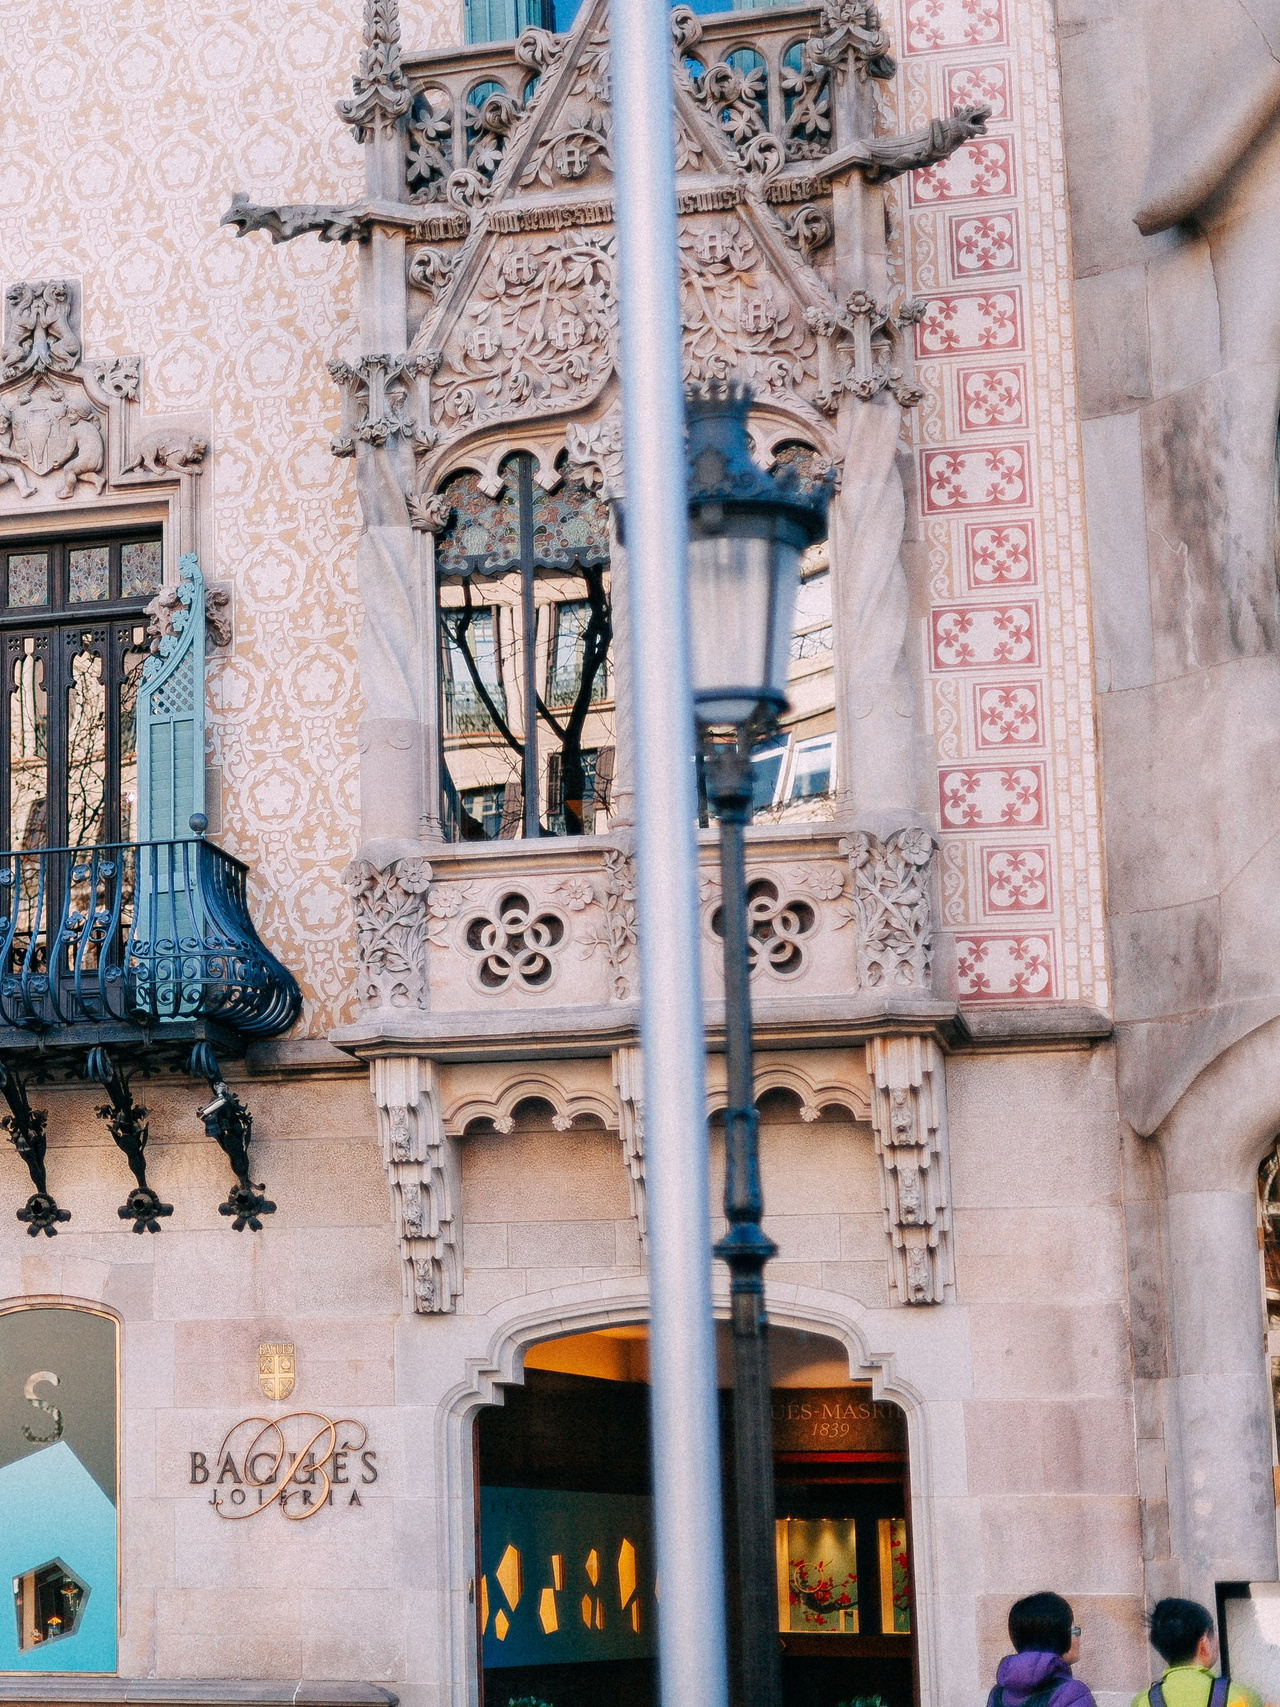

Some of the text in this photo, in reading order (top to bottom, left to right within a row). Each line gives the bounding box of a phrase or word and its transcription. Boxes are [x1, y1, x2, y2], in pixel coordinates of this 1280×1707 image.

[810, 1422, 851, 1438] 1839
[189, 1441, 378, 1485] BAGUÉS
[209, 1489, 363, 1507] JOIERIA
